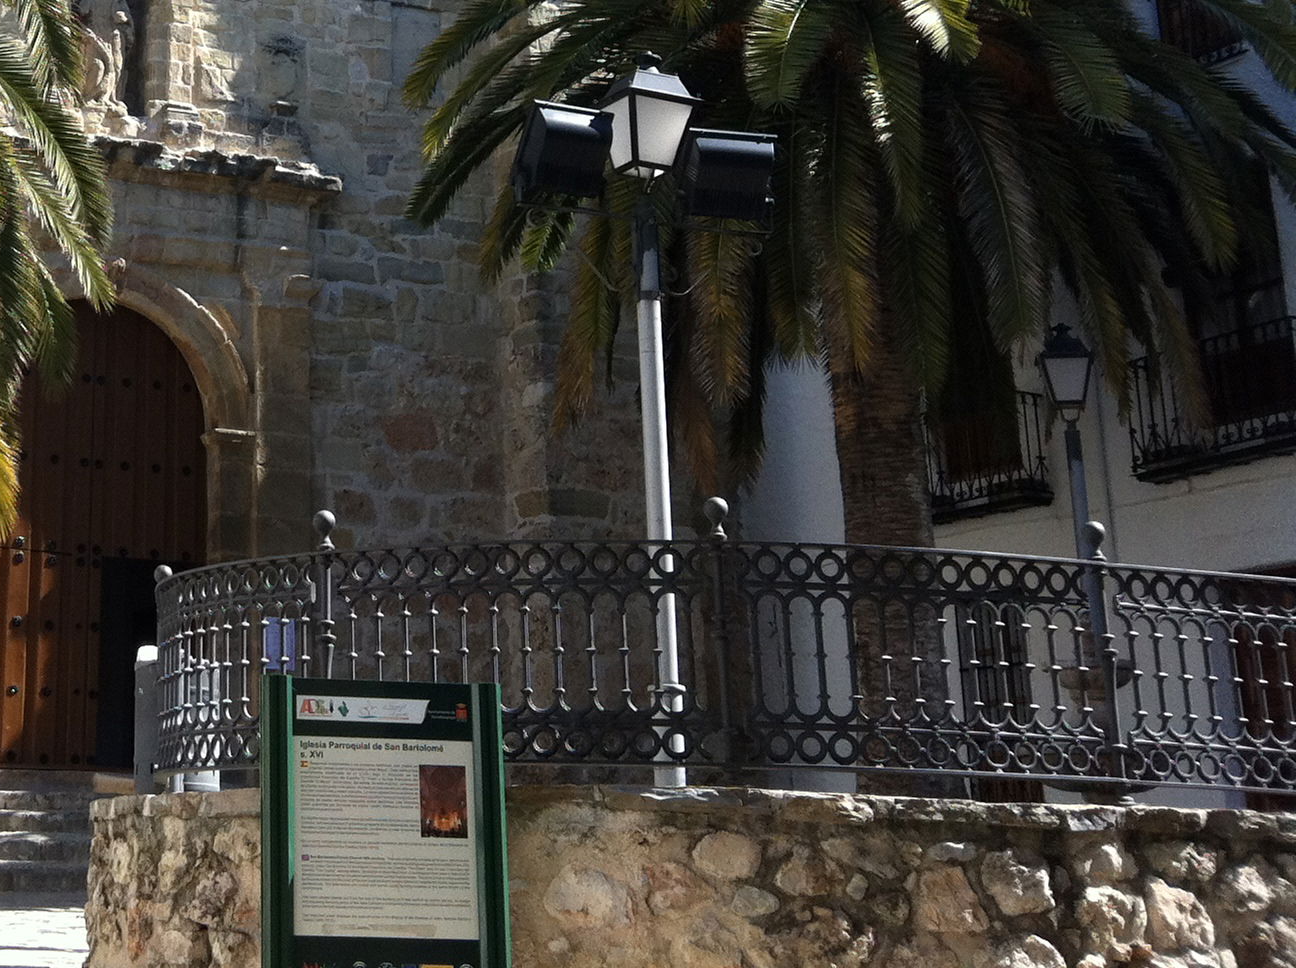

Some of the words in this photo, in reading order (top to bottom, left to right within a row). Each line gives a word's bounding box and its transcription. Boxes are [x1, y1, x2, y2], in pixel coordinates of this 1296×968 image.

[300, 740, 326, 750] Iglesia
[328, 741, 370, 751] Parroquial
[372, 742, 383, 750] de
[384, 743, 401, 751] San
[402, 743, 444, 752] Bartolomé
[309, 750, 324, 759] XVI
